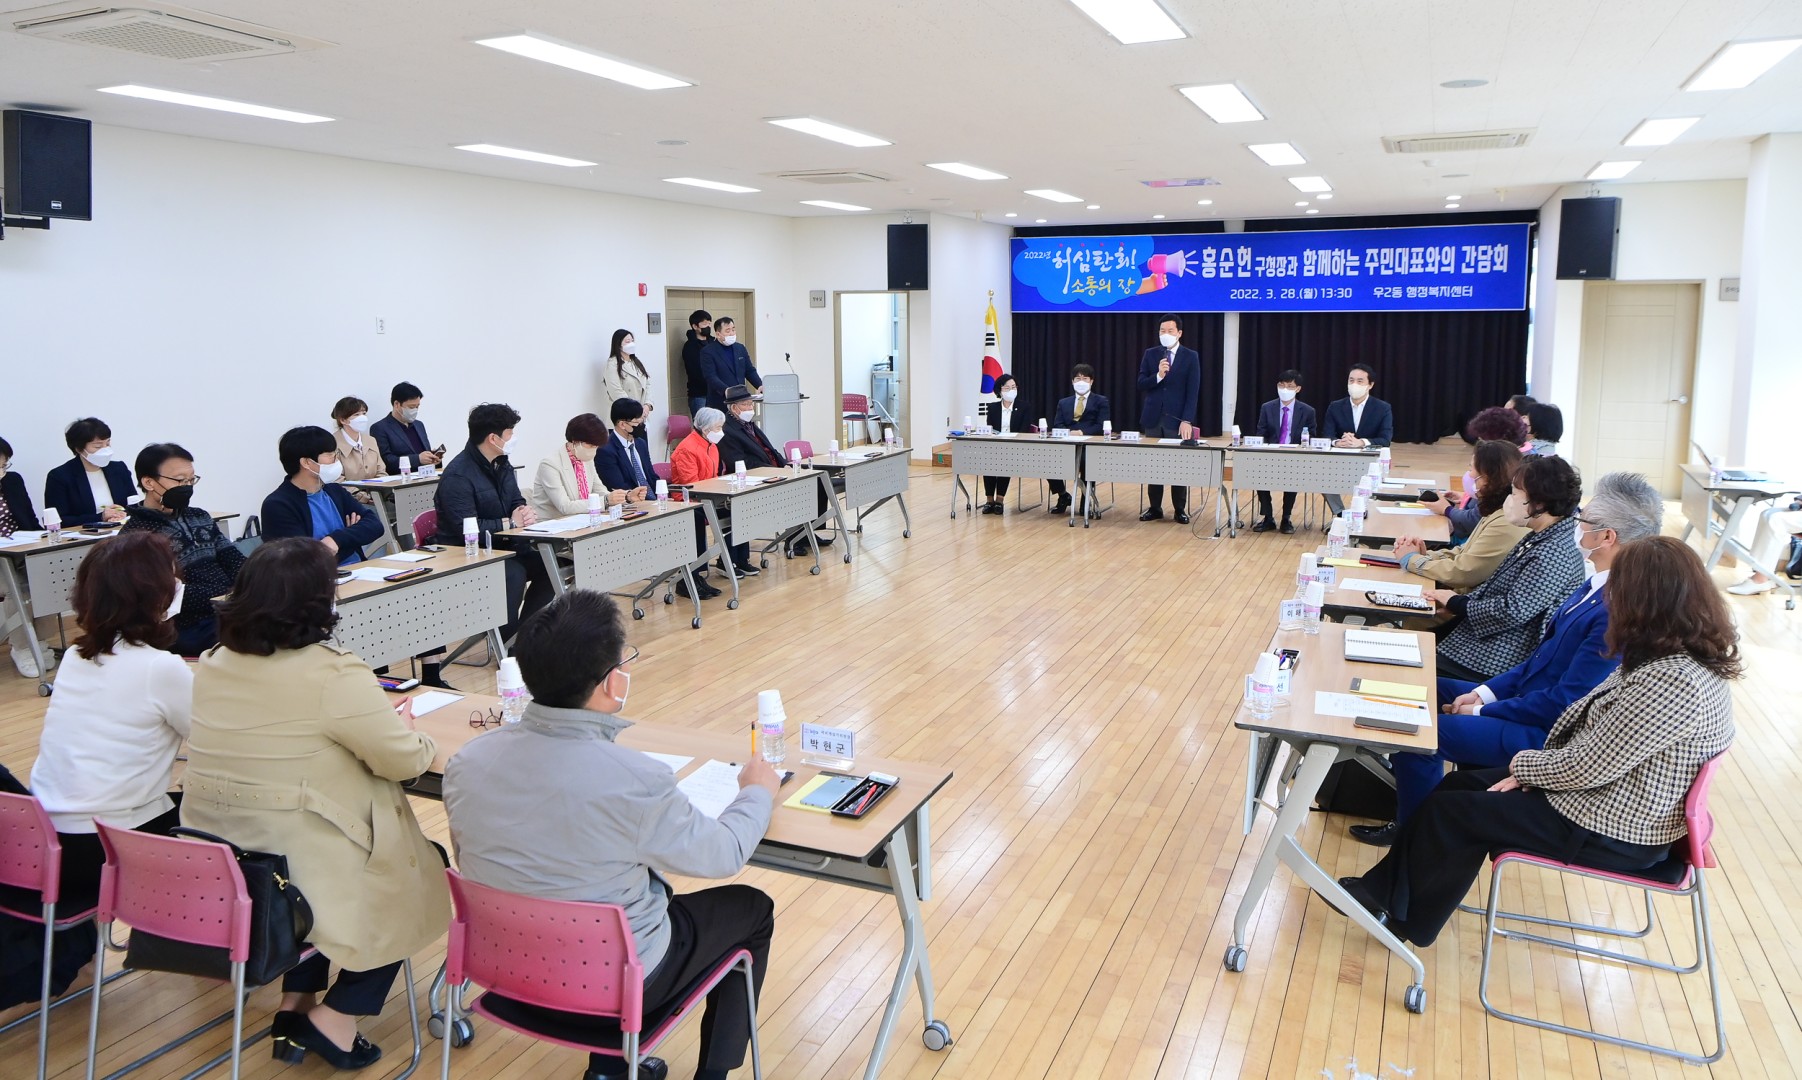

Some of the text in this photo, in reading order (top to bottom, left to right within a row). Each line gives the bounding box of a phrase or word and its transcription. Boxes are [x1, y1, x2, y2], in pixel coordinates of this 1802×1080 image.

[1024, 251, 1051, 260] 2022년
[1201, 243, 1509, 278] 홍순헌 구청장과 함께하는 주민대표와의 간담회
[1071, 275, 1135, 296] 소통의 장
[1230, 289, 1262, 300] 2022.
[1266, 289, 1276, 300] 3.
[1320, 287, 1352, 298] 13:30
[1373, 286, 1403, 298] 우2동
[1406, 285, 1473, 298] 행정복지센터
